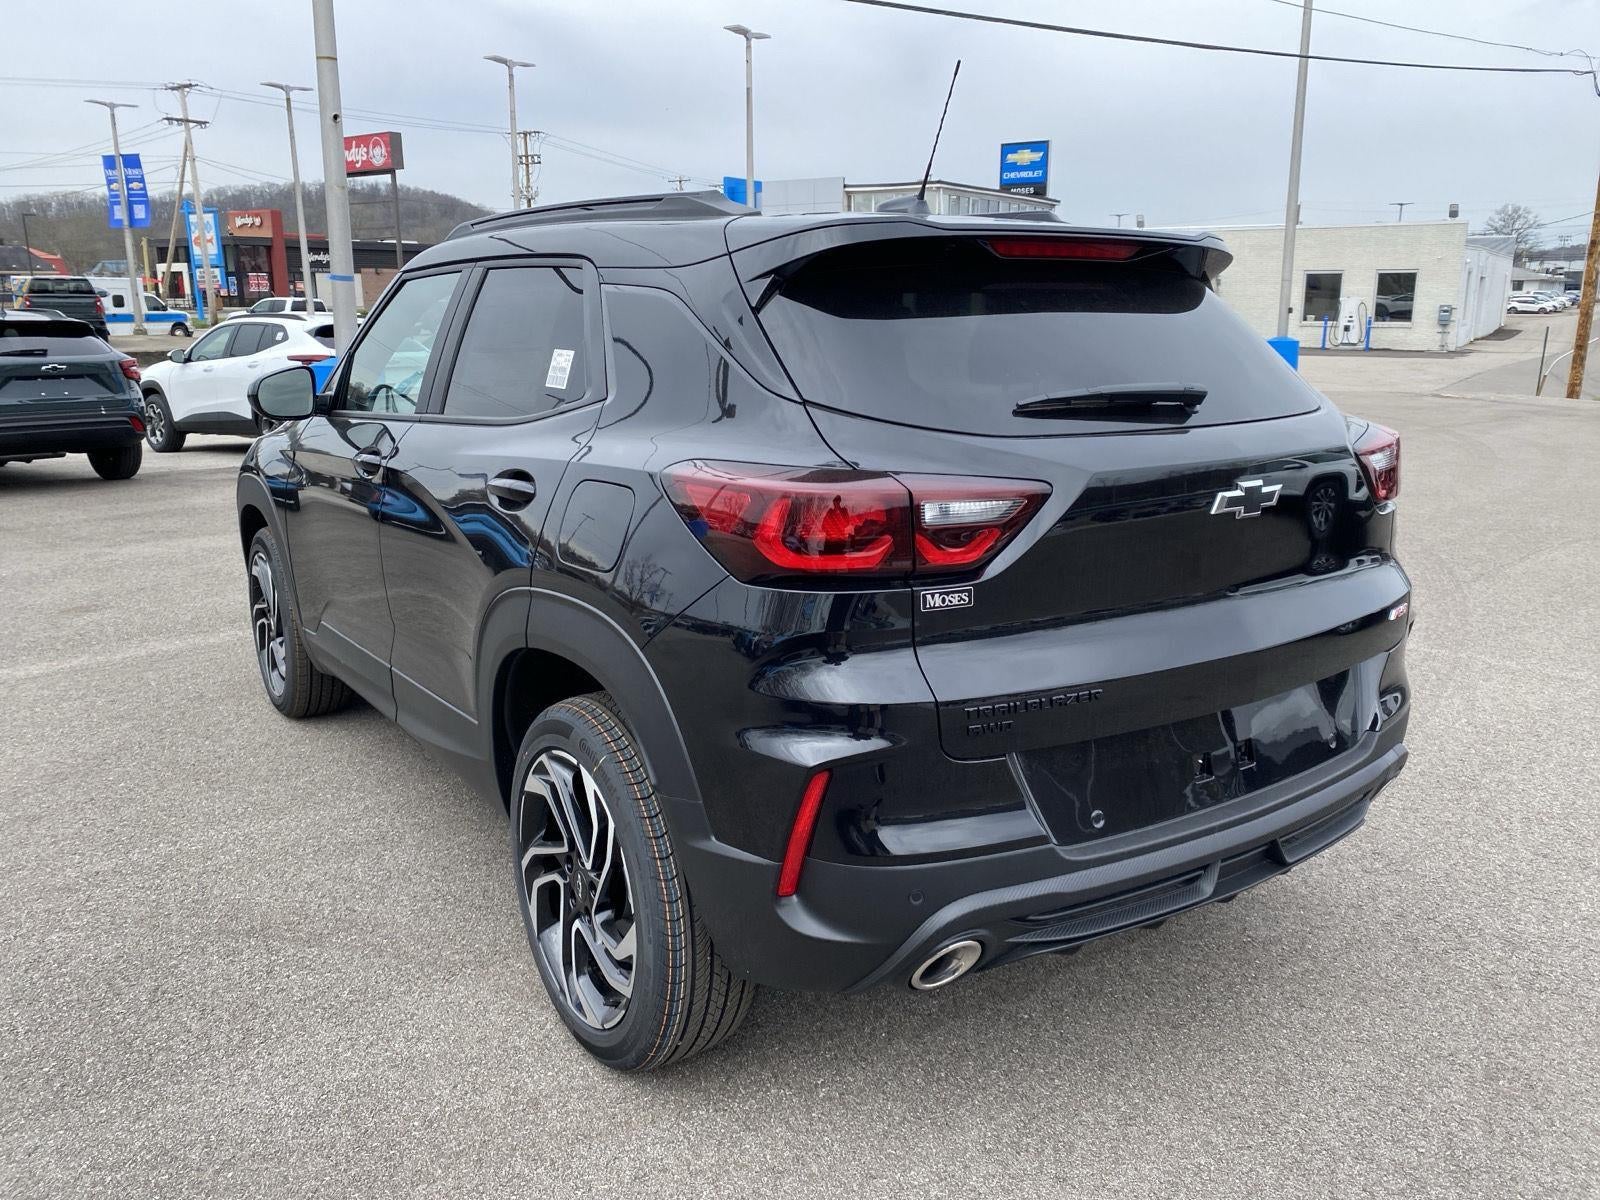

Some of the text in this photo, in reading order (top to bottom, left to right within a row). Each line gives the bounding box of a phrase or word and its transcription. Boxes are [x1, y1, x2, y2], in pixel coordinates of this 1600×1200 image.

[343, 141, 367, 167] ndy's
[1003, 170, 1043, 179] CHEVROLET
[925, 592, 969, 608] MOSES
[964, 689, 1103, 719] TRAILBLAZER
